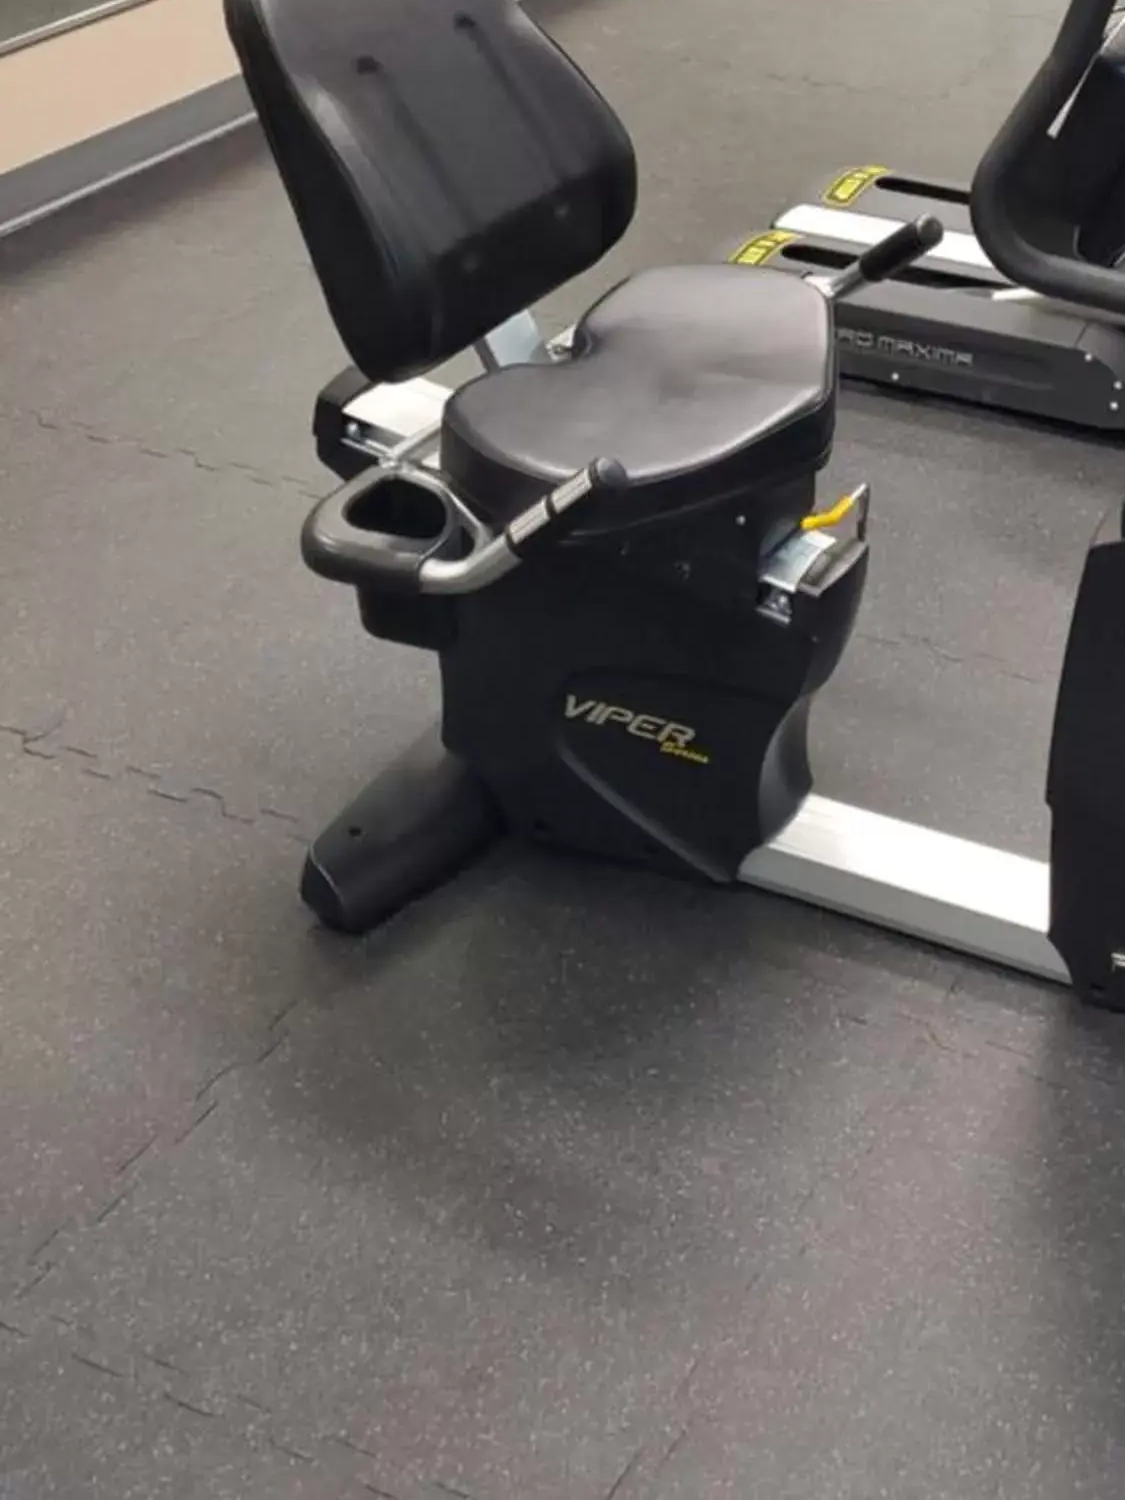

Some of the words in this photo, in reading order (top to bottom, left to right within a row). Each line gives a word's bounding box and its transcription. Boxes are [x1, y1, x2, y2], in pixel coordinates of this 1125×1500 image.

[836, 327, 874, 348] RO
[878, 335, 974, 368] MAXIMA
[564, 693, 696, 749] VIPER
